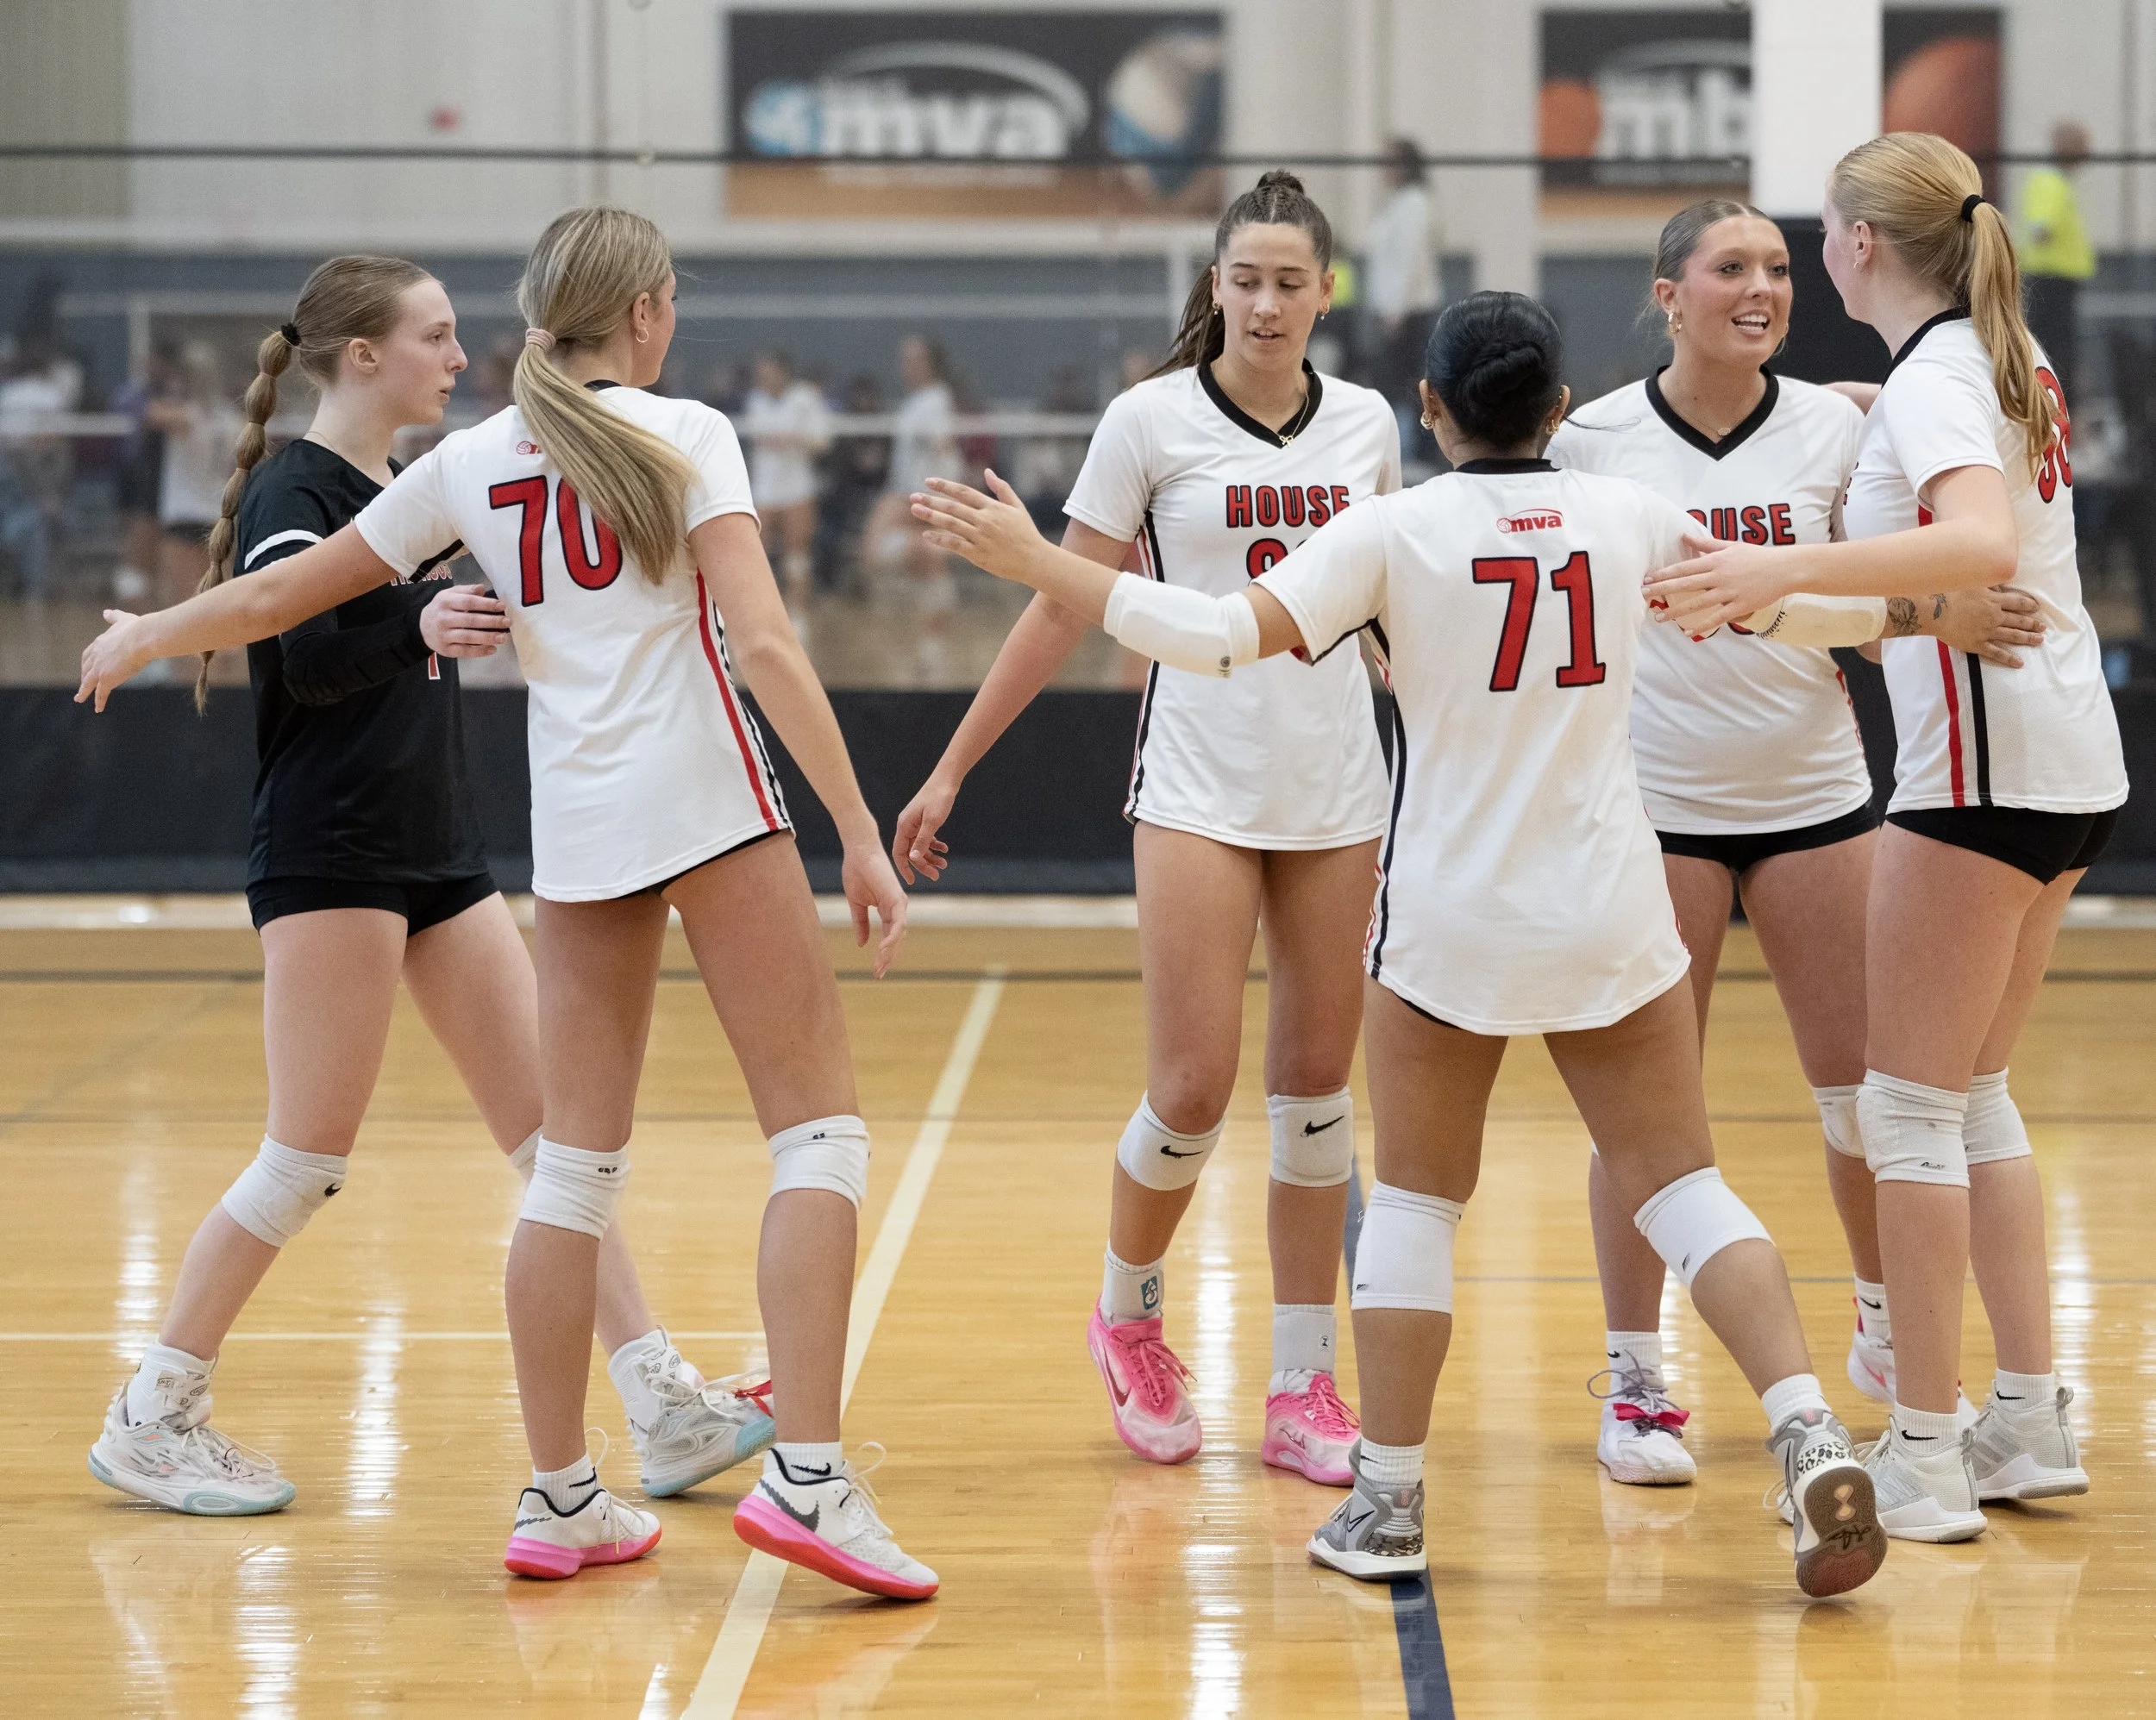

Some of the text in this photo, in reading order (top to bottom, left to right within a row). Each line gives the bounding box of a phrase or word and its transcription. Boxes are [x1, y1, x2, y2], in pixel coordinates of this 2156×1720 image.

[821, 93, 1069, 157] mva
[1226, 485, 1350, 528] HOUSE
[1510, 515, 1562, 532] mva
[488, 475, 623, 607] 70
[1471, 550, 1606, 691] 71
